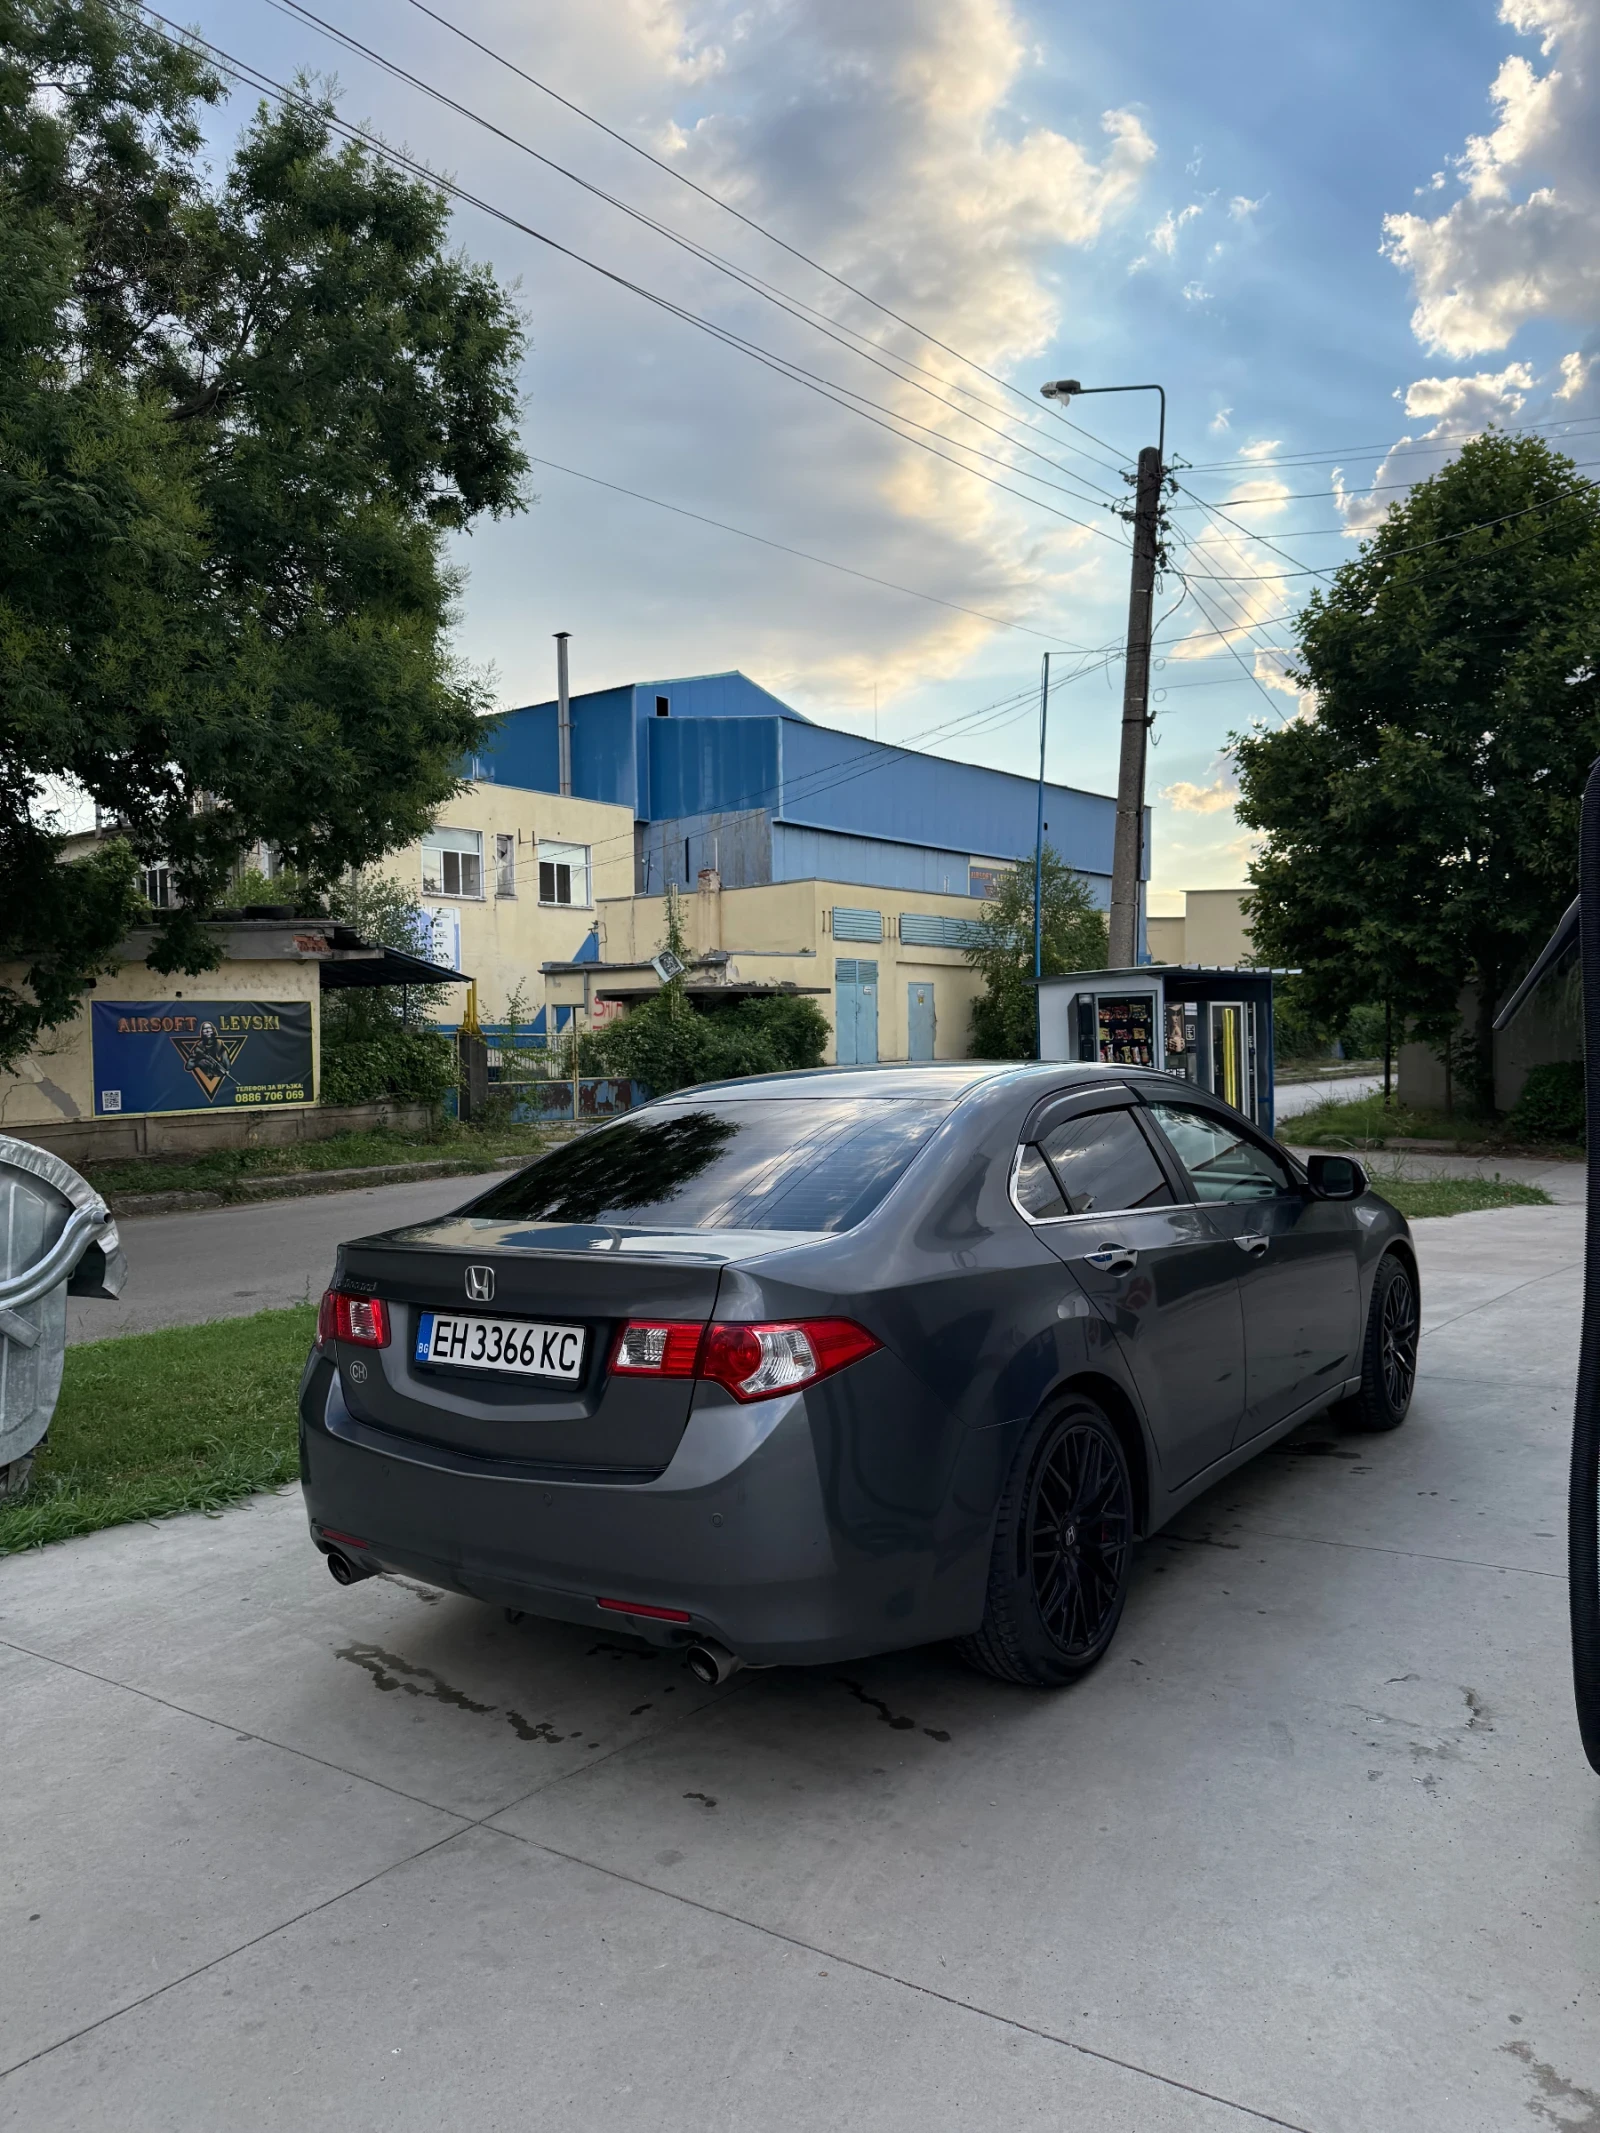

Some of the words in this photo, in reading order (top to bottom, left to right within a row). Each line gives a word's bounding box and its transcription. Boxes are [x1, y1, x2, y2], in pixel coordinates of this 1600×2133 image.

[118, 1016, 197, 1033] AIRSOFT
[219, 1015, 280, 1031] LEVSKI
[236, 1093, 261, 1103] 0886
[264, 1091, 283, 1101] 706
[286, 1090, 304, 1100] 069
[418, 1342, 429, 1354] BG
